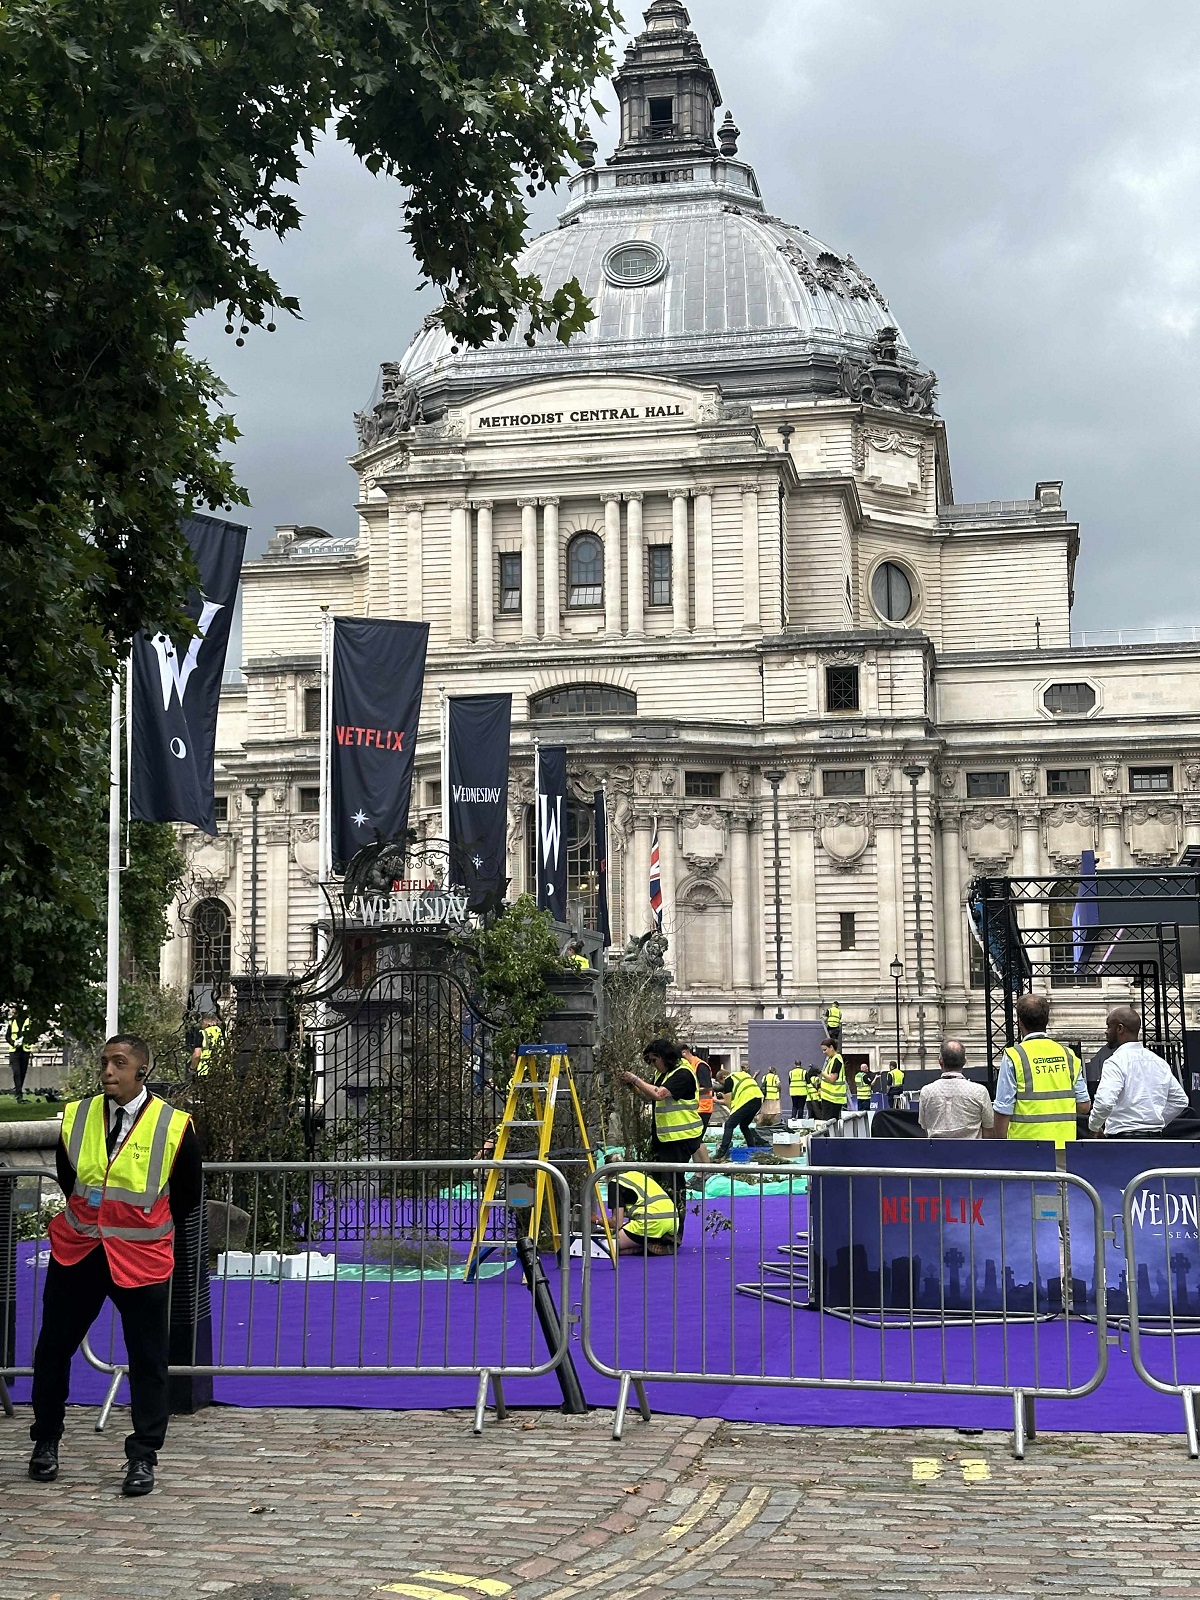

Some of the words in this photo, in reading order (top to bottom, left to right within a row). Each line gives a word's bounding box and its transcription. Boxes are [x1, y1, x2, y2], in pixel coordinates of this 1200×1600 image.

[478, 412, 564, 428] METHODIST
[570, 407, 639, 422] CENTRAL
[645, 404, 684, 418] HALL
[452, 784, 501, 804] WEDNESDAY
[539, 794, 563, 872] W
[392, 880, 435, 892] NETFLIX
[358, 893, 470, 926] WEDNESDAY
[1035, 1064, 1066, 1074] STAFF
[881, 1196, 985, 1226] NETFLIX
